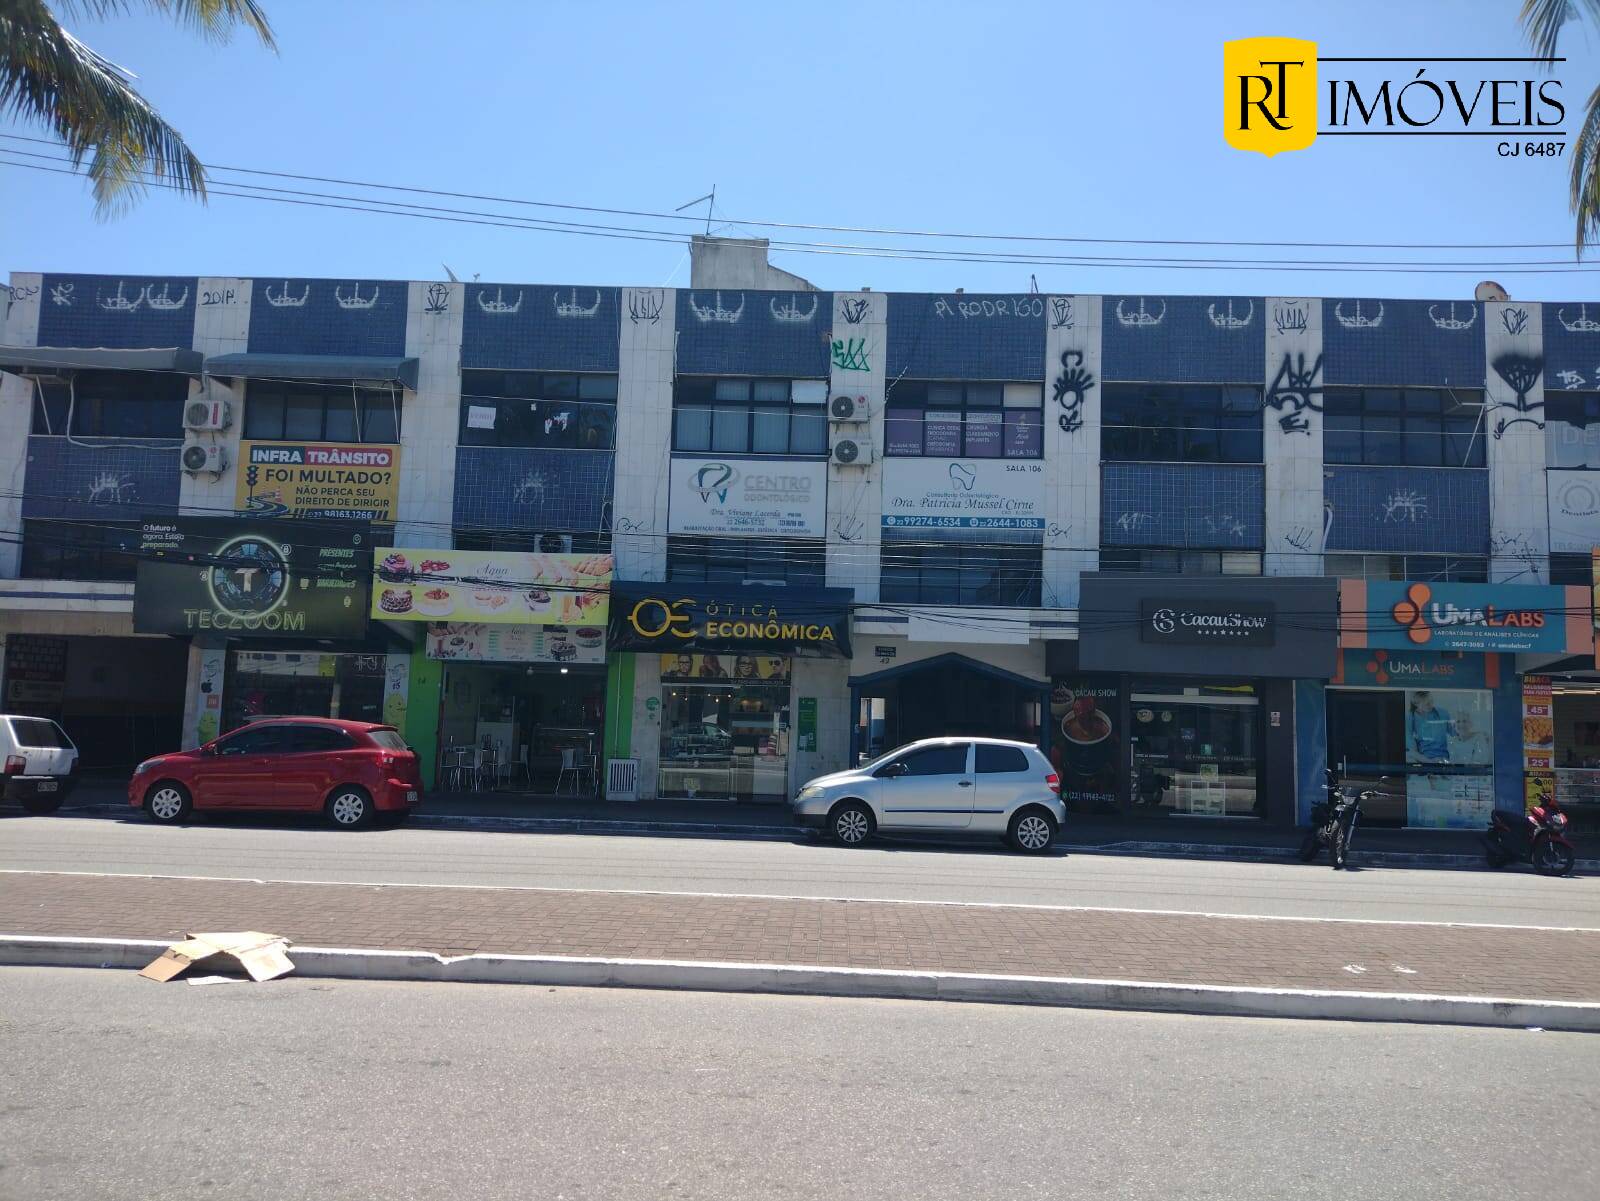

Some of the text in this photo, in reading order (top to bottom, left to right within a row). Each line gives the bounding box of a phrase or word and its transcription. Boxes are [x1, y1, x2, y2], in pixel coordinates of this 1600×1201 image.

[958, 298, 1043, 319] RODRIGO
[252, 448, 391, 465] INFRA TRÂNSITO
[1029, 465, 1042, 473] 106
[265, 469, 392, 485] FOI MULTADO?
[743, 475, 813, 490] CENTRO
[296, 486, 375, 497] NÃO PERCA SEU
[295, 497, 390, 508] DIREITO DE DIRIGIR
[891, 497, 916, 508] Dra.
[964, 497, 1005, 509] Mussel
[1005, 499, 1034, 511] Cirne
[904, 517, 961, 526] 99274-6534
[987, 518, 1039, 528] 2644-1083
[149, 524, 171, 532] futuro
[320, 548, 354, 557] PRESENTES
[706, 600, 778, 617] ÓTICA
[184, 609, 305, 631] TECZOOM
[706, 619, 834, 642] ECONÔMICA
[1098, 688, 1117, 697] SHOW
